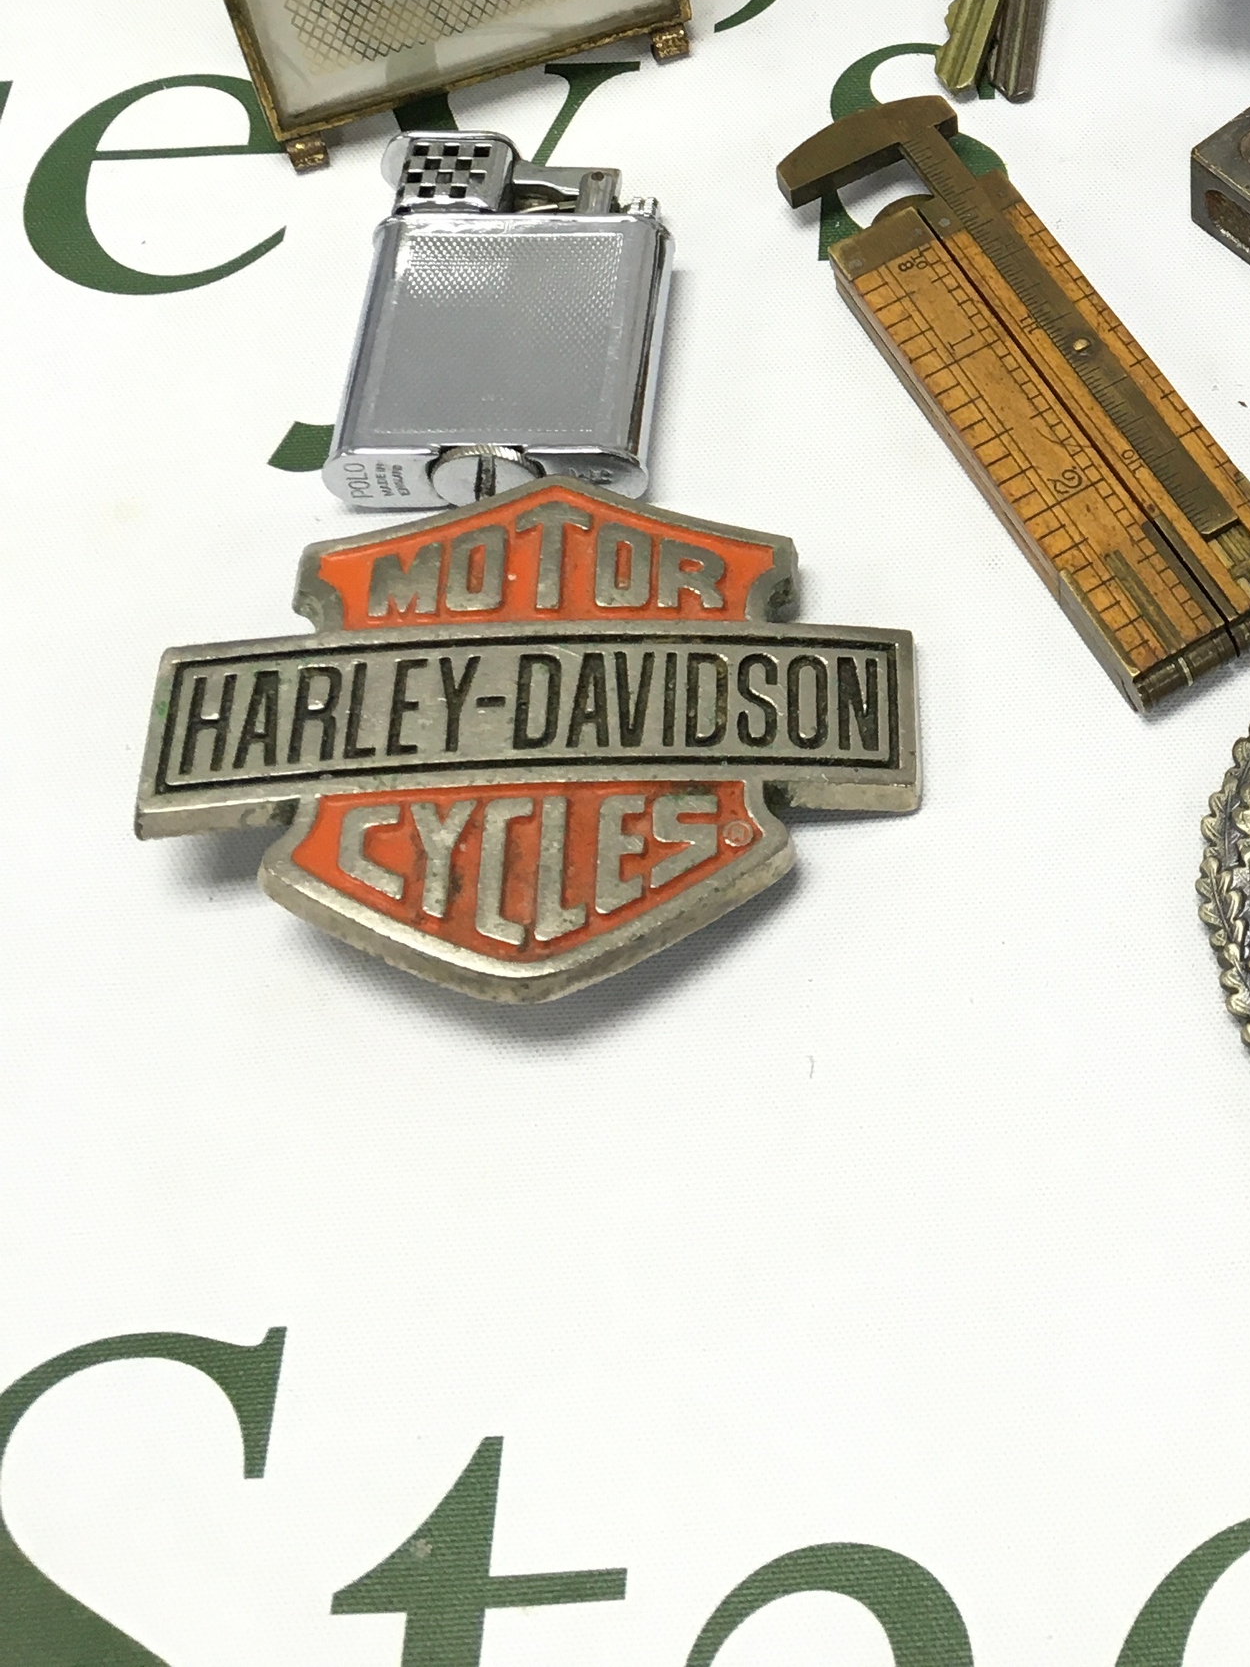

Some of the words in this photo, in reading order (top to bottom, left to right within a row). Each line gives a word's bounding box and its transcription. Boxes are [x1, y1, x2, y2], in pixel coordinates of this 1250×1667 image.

[946, 328, 975, 352] 1
[342, 461, 374, 500] POLO
[1046, 465, 1083, 496] 2
[368, 499, 729, 620] MOTOR
[177, 649, 883, 775] HARLEY-DAVIDSON
[336, 792, 720, 947] CYCLES
